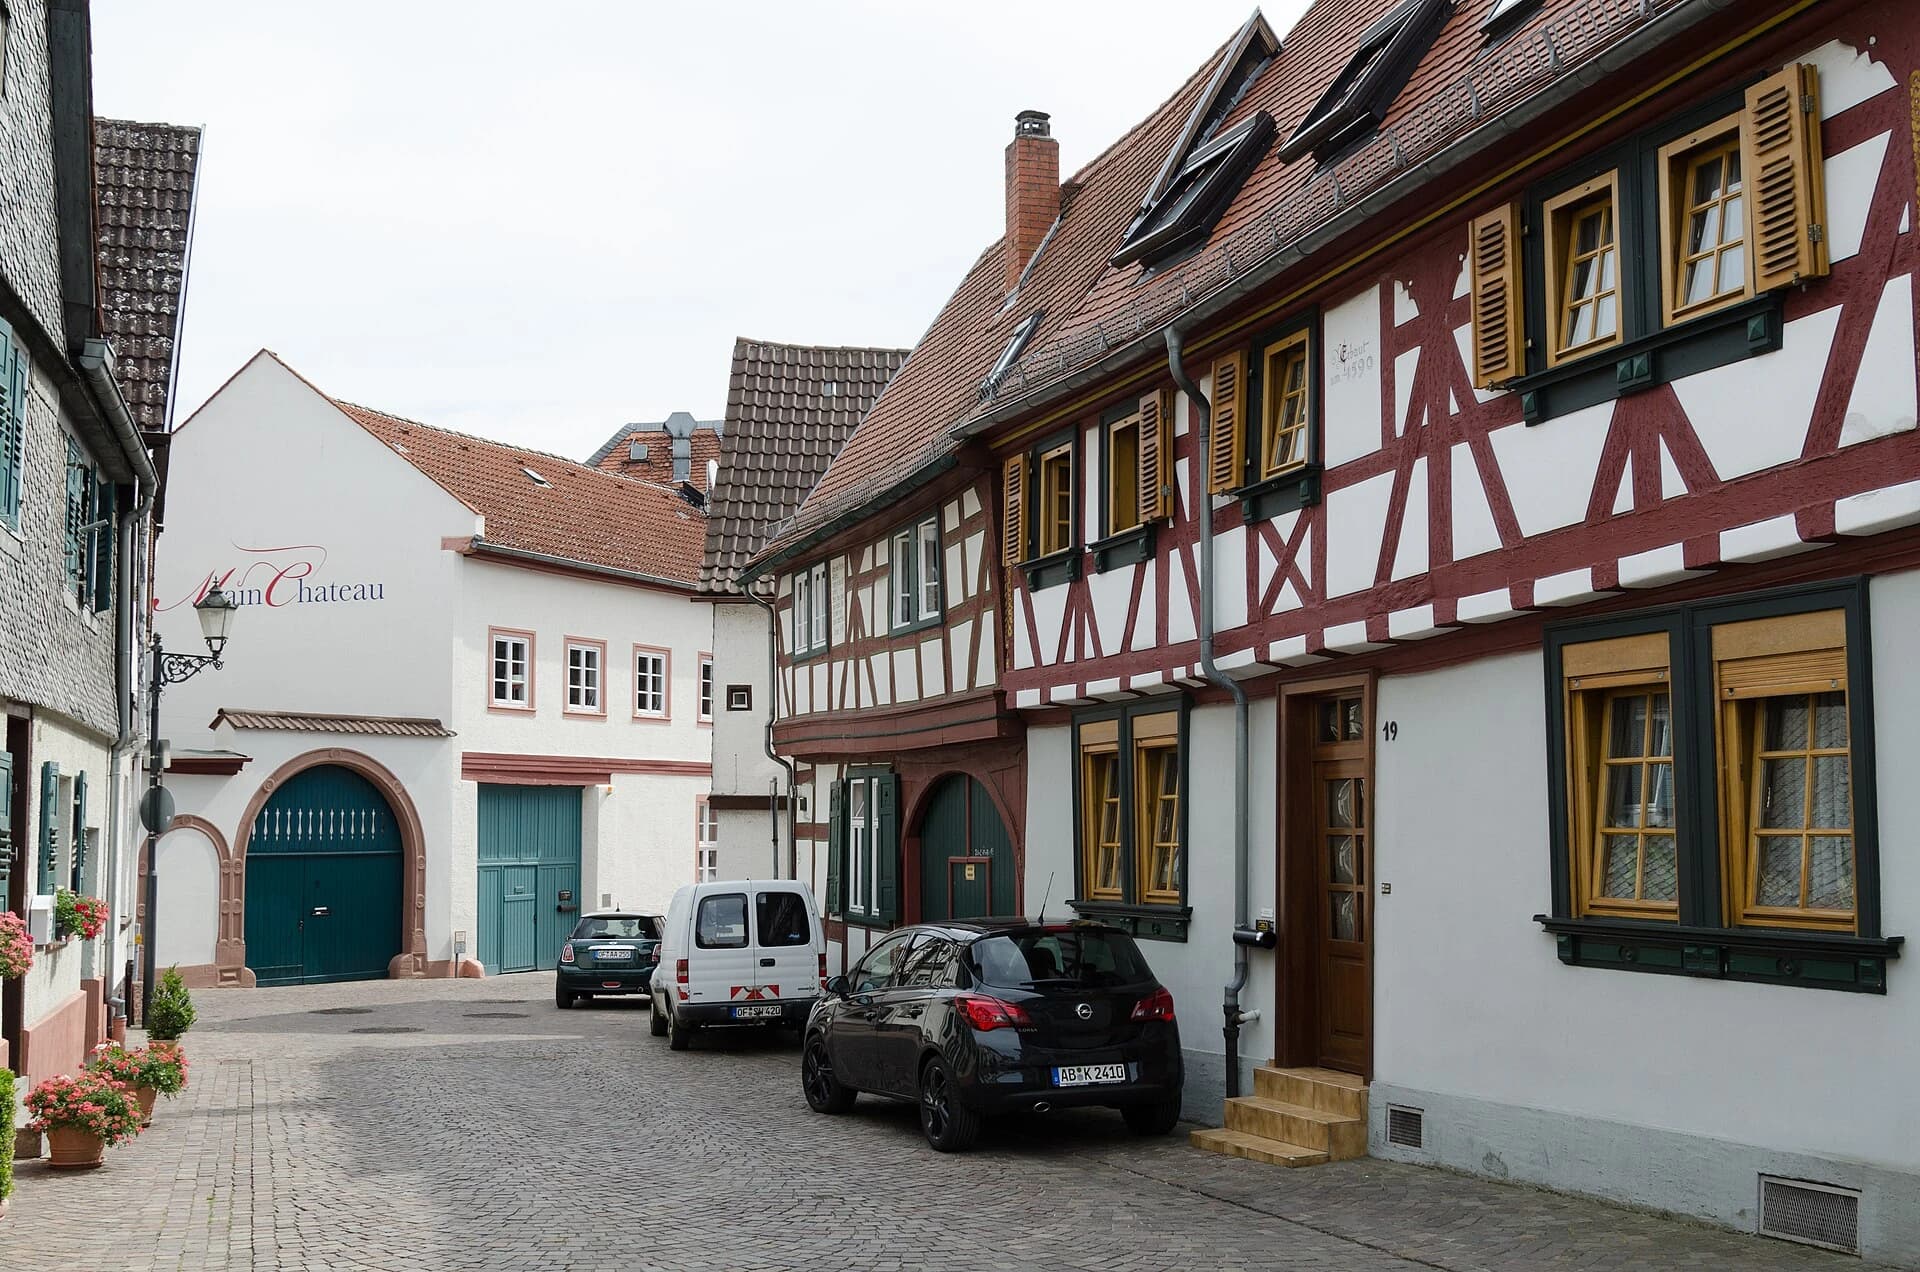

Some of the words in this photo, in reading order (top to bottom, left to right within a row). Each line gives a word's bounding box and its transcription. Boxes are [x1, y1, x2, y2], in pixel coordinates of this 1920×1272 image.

[1341, 355, 1373, 380] 1590
[237, 561, 384, 608] Chateau
[1382, 720, 1398, 742] 19
[737, 1008, 748, 1017] OF
[765, 1006, 781, 1015] 420
[1061, 1068, 1077, 1082] AB
[1083, 1067, 1093, 1081] K
[1094, 1065, 1124, 1080] 2410
